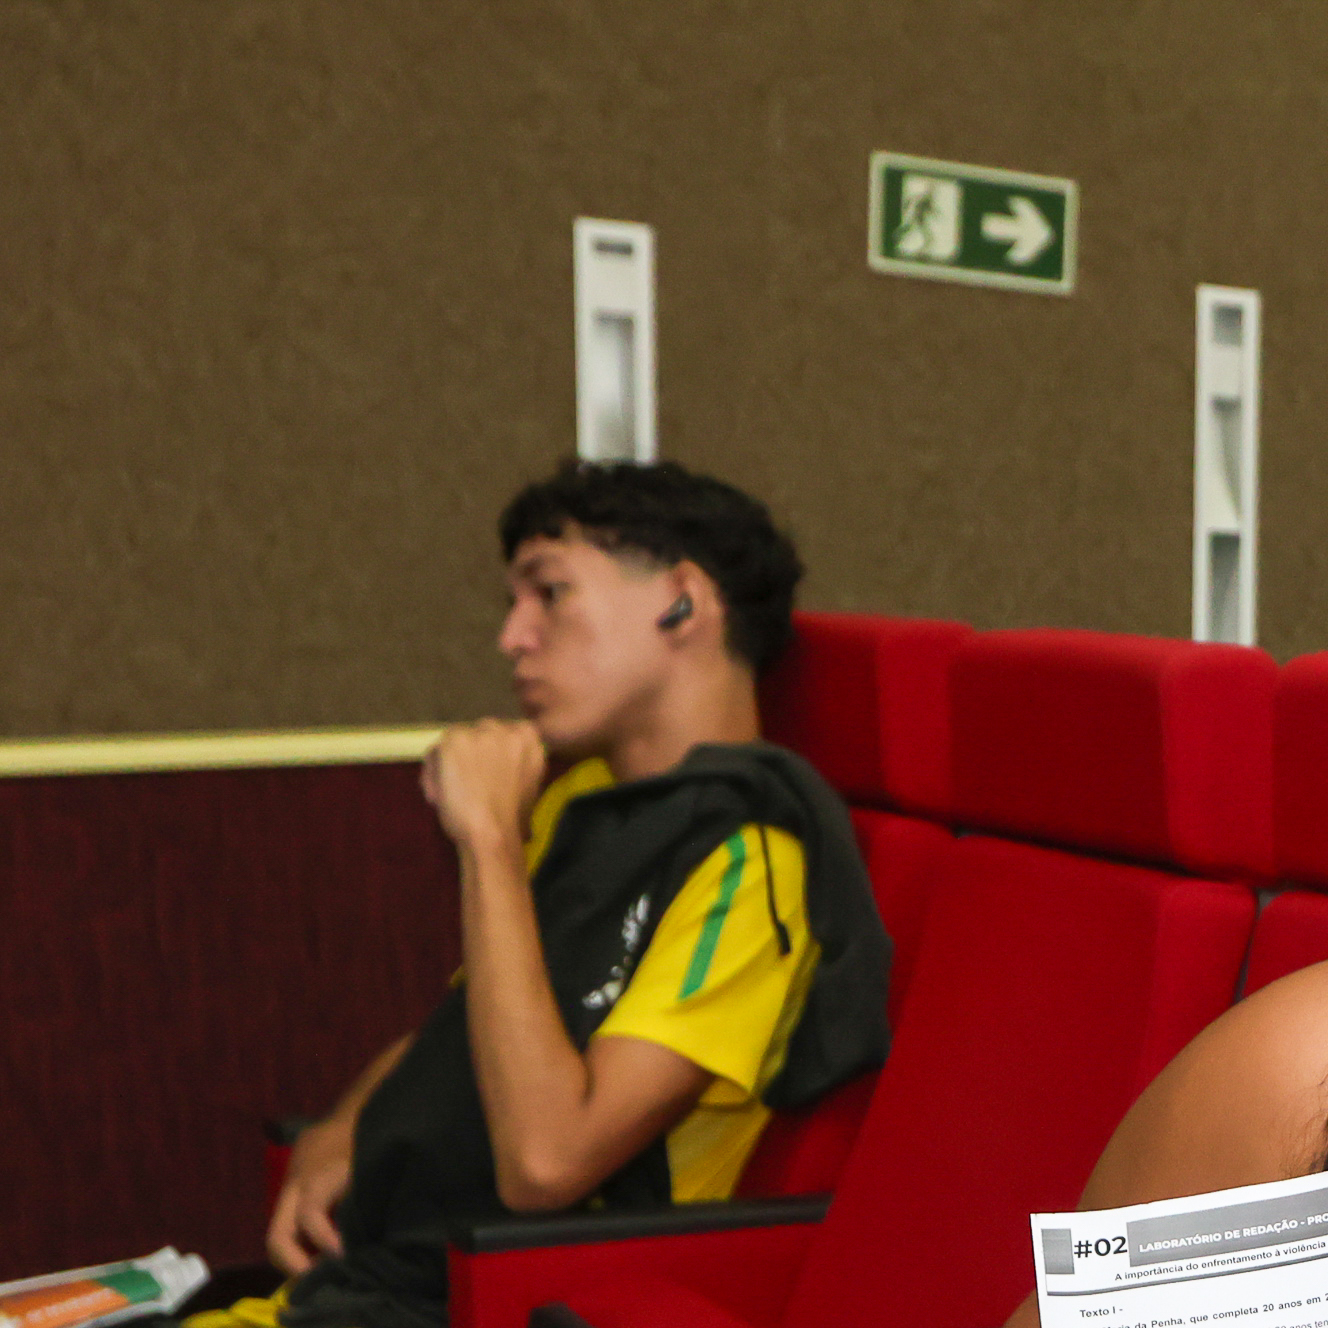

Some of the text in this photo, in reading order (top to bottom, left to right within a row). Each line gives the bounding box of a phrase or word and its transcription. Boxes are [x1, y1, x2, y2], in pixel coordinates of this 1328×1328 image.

[1074, 1236, 1128, 1258] #02
[1139, 1232, 1222, 1252] LABORATÓRIO
[1224, 1230, 1240, 1240] DE
[1242, 1219, 1298, 1237] REDAÇÃO
[1115, 1273, 1122, 1281] A
[1125, 1264, 1183, 1280] importância
[1186, 1262, 1199, 1271] do
[1201, 1251, 1272, 1268] enfrentamento
[1283, 1240, 1326, 1255] violência
[1080, 1308, 1109, 1318] Texto
[1151, 1318, 1186, 1328] Penha,
[1189, 1314, 1208, 1324] que
[1212, 1307, 1258, 1320] completa
[1262, 1303, 1274, 1312] 20
[1278, 1300, 1302, 1310] anos
[1306, 1296, 1321, 1305] em
